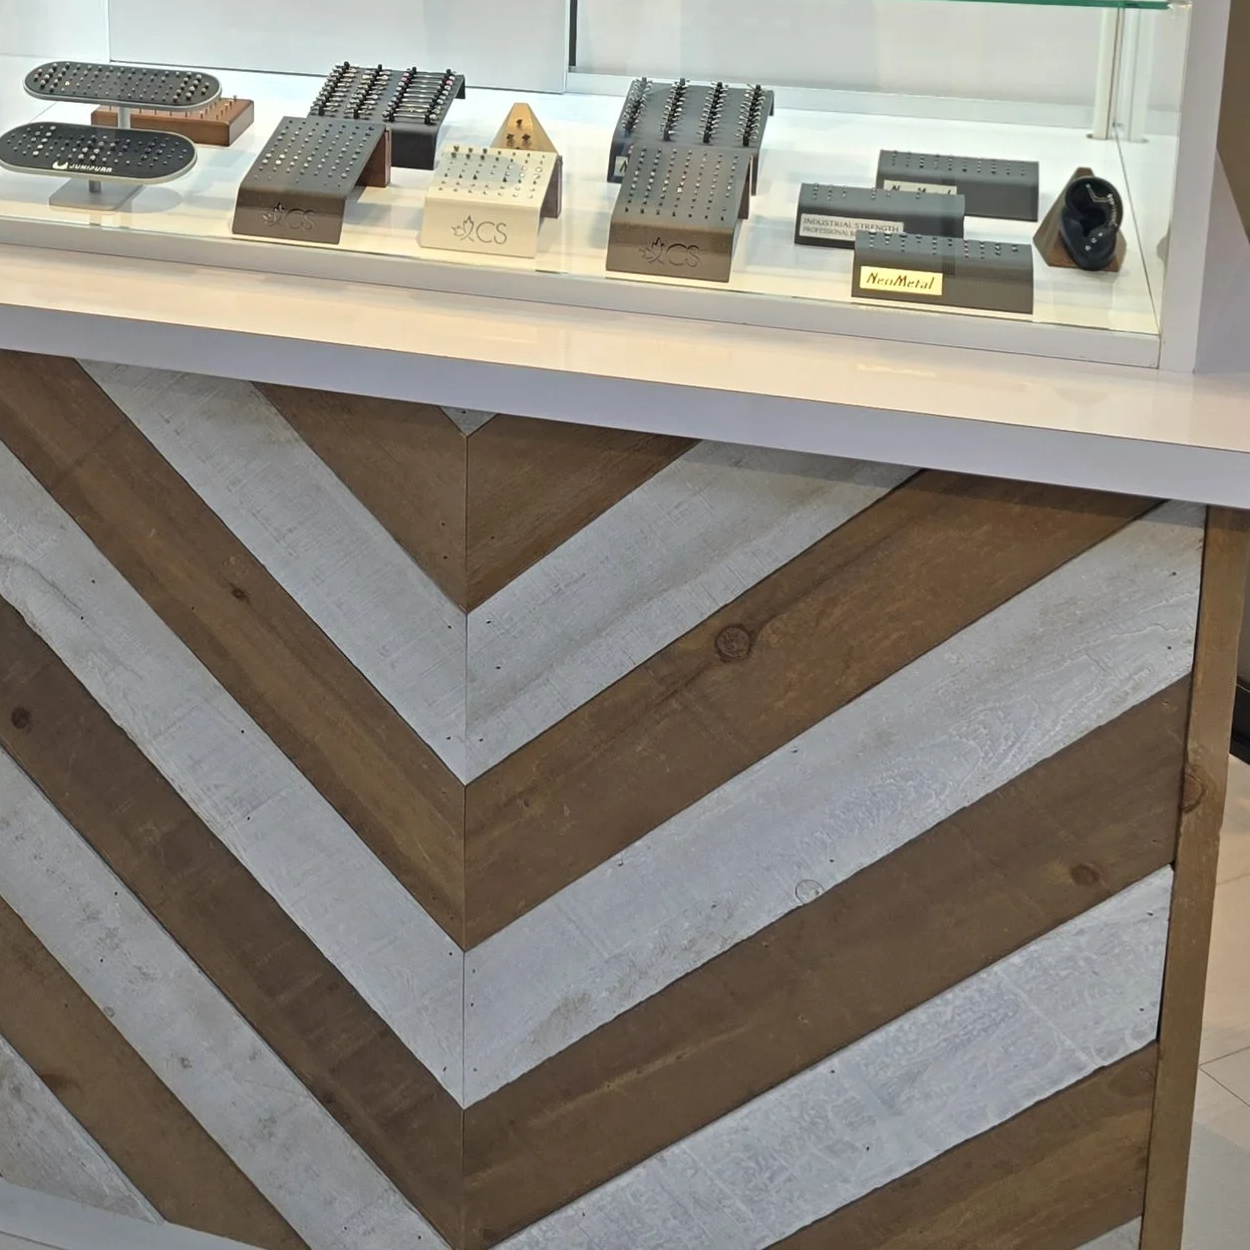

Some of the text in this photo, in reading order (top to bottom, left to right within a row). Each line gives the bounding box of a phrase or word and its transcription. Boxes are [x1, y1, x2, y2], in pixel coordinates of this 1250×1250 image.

[68, 161, 113, 173] JUNIPURR
[285, 208, 314, 230] CS
[803, 217, 899, 232] INDUSTRIAL STRENGTH
[475, 221, 507, 245] CS
[802, 227, 848, 236] PROFESSIONAL
[666, 243, 699, 267] CS
[866, 272, 935, 290] NeoMetal
